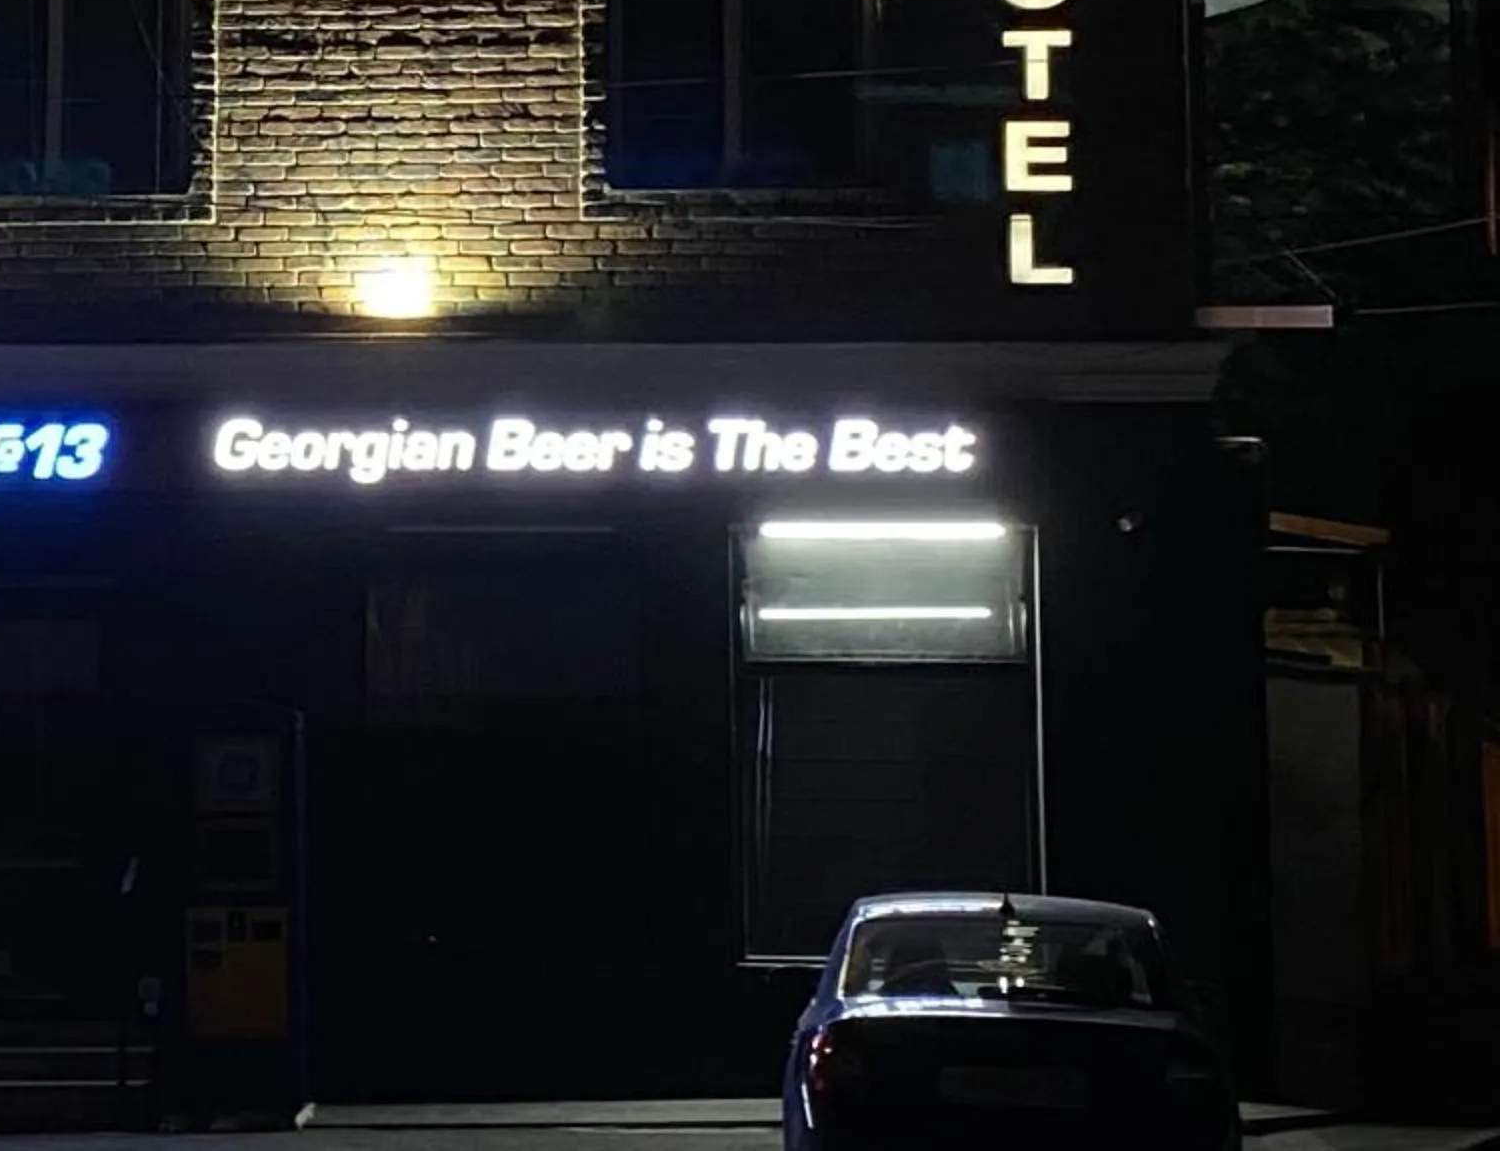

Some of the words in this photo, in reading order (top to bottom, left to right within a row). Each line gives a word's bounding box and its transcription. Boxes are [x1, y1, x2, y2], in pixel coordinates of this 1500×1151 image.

[214, 417, 477, 485] Georgian
[486, 417, 634, 472] Beer
[638, 418, 696, 472] is
[707, 418, 818, 472] The
[828, 418, 976, 472] Best
